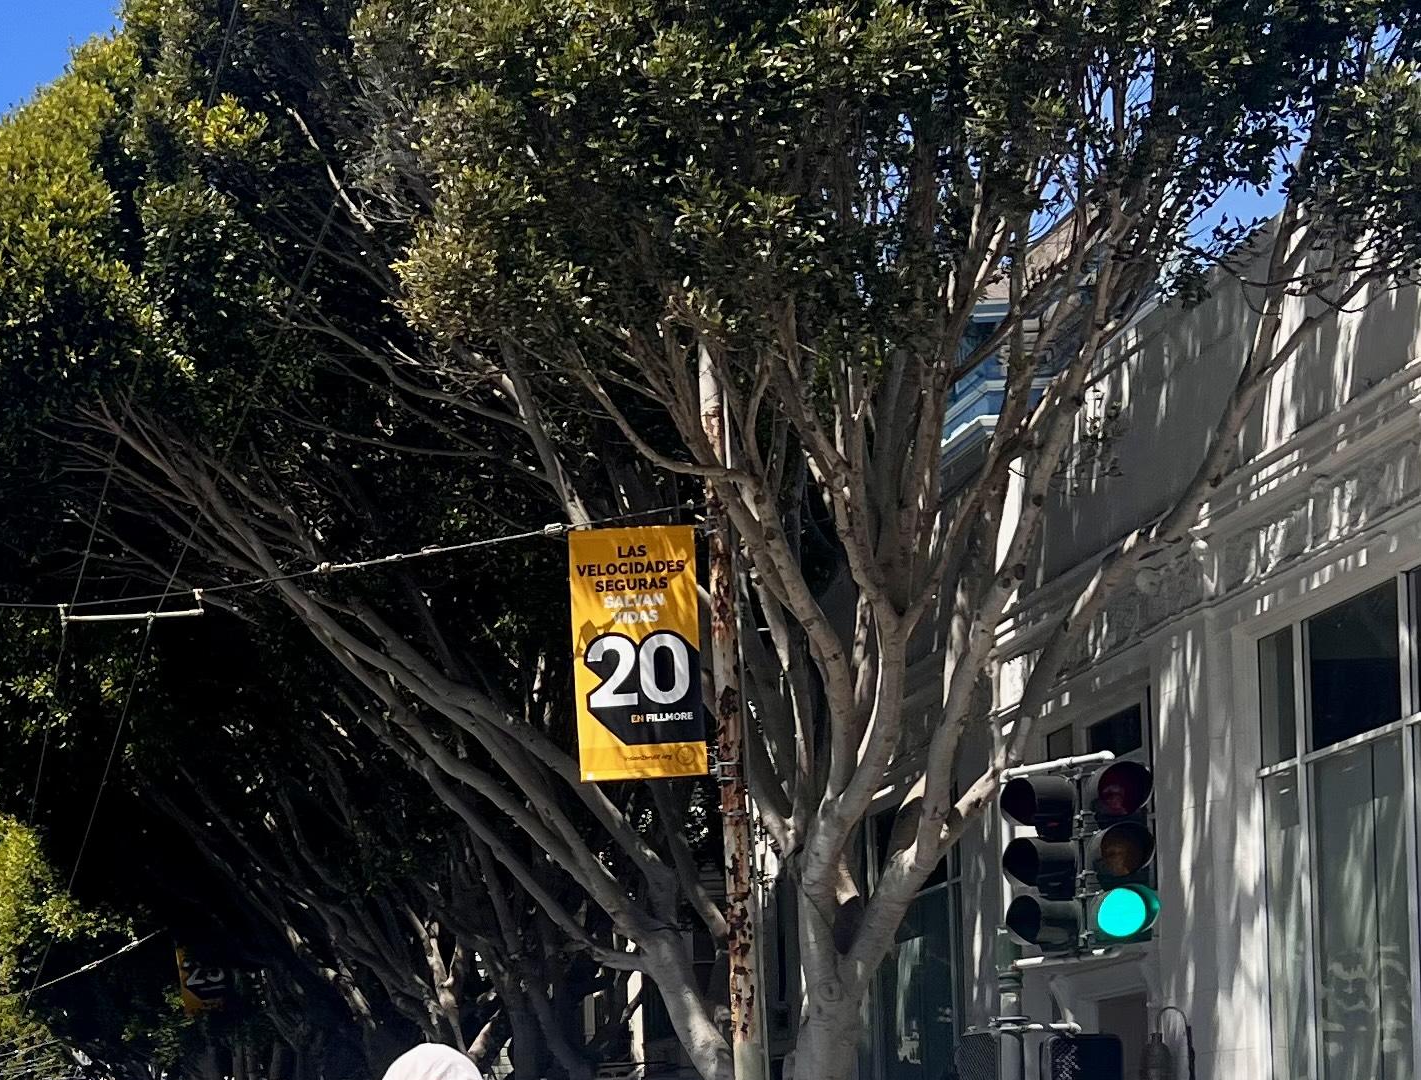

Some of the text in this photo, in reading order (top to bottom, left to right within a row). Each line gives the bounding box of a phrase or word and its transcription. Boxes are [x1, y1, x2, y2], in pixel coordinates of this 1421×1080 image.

[617, 545, 647, 558] LAS
[576, 559, 685, 577] VELOCIDADES
[595, 576, 668, 592] SEGURAS
[603, 592, 665, 609] SALVAN
[611, 609, 659, 624] VIDAS
[587, 632, 690, 708] 20
[646, 711, 694, 723] FILLMORE
